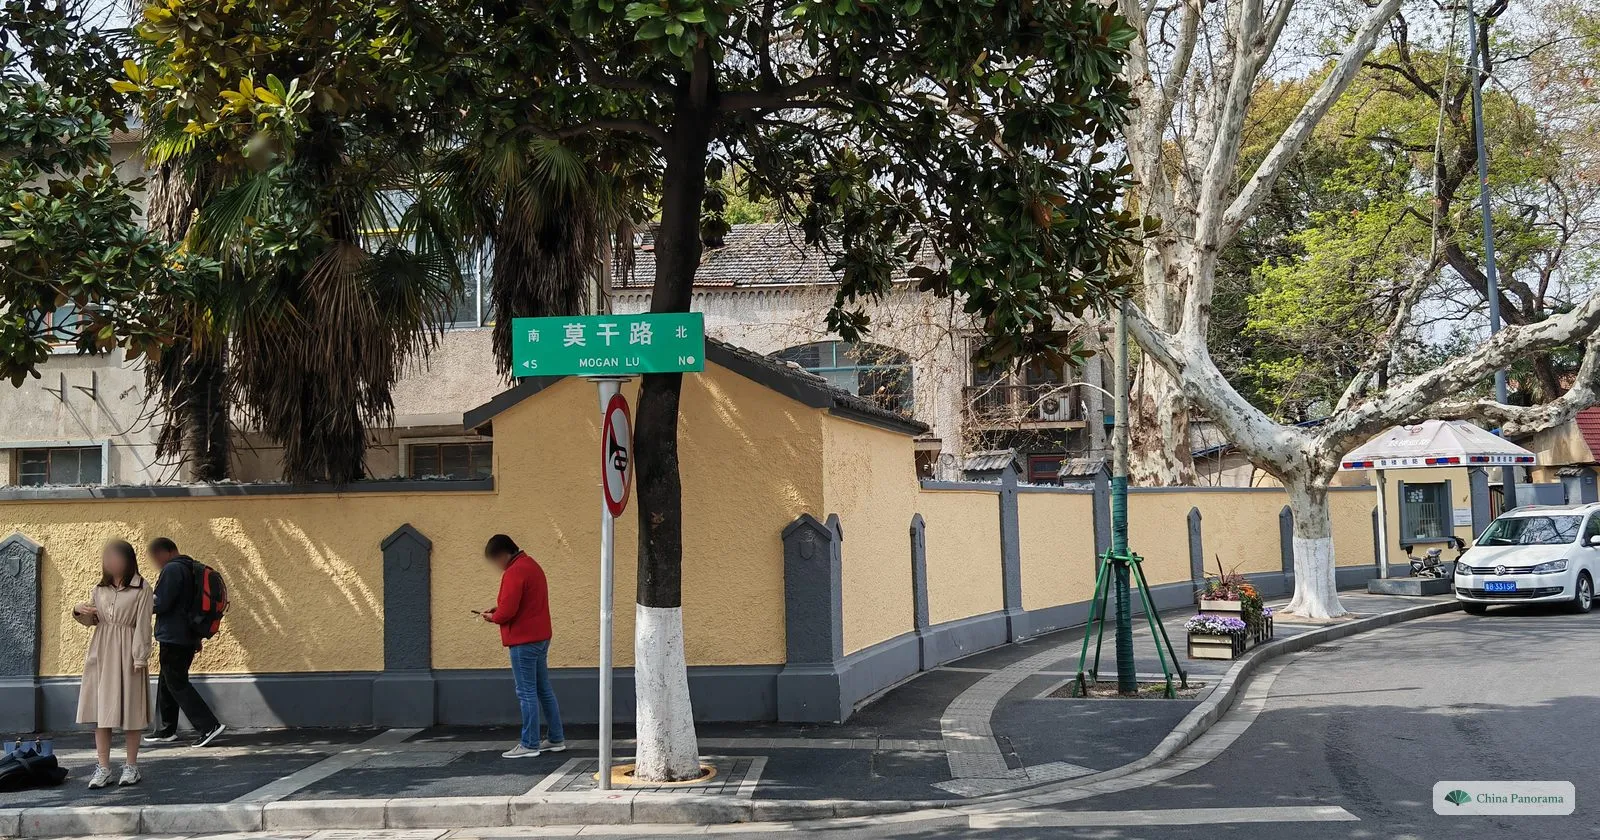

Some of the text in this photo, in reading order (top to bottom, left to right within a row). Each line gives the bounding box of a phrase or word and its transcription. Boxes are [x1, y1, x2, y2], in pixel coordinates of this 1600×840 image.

[528, 329, 540, 343] 南
[563, 321, 653, 347] 莫干路
[675, 325, 688, 339] 北
[530, 360, 538, 369] S
[579, 357, 640, 368] MOGAN LU
[678, 356, 686, 365] N
